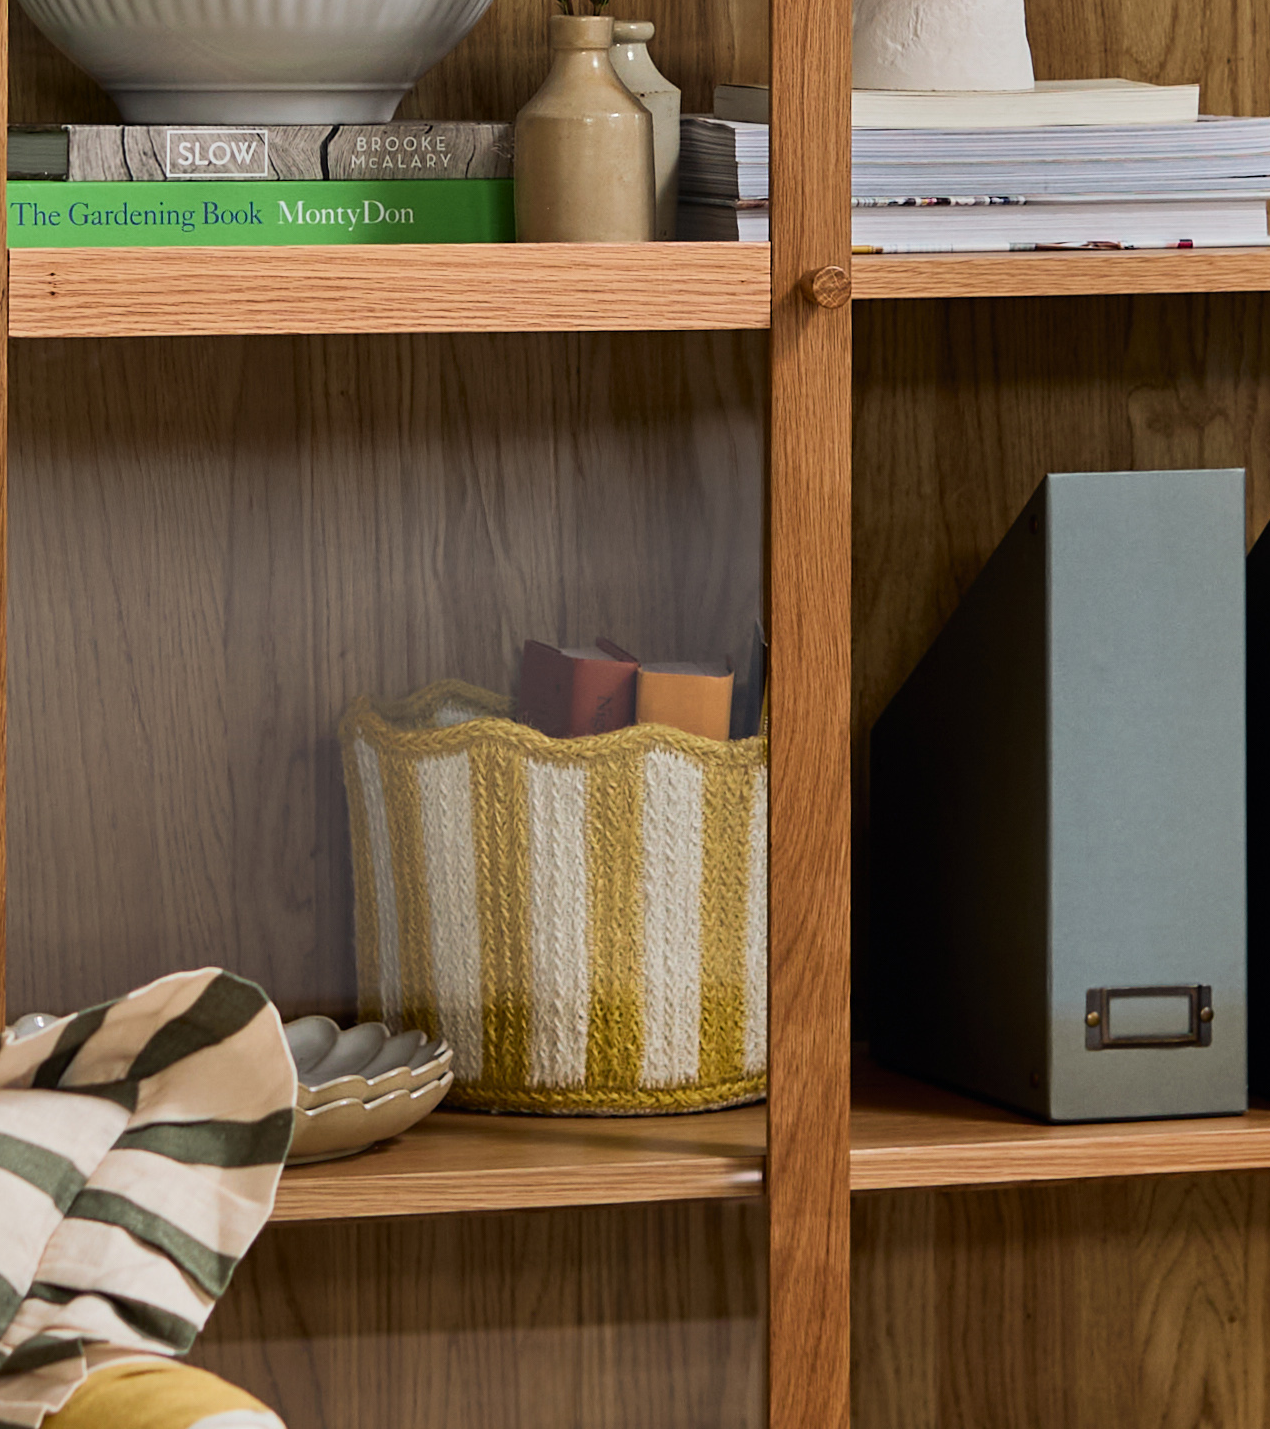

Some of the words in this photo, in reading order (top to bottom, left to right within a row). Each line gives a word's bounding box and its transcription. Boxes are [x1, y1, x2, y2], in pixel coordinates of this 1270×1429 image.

[177, 141, 257, 166] SLOW
[356, 136, 447, 152] BROOKE
[351, 153, 452, 169] McALARY
[10, 201, 61, 226] The
[67, 201, 196, 233] Gardening
[202, 201, 264, 225] Book
